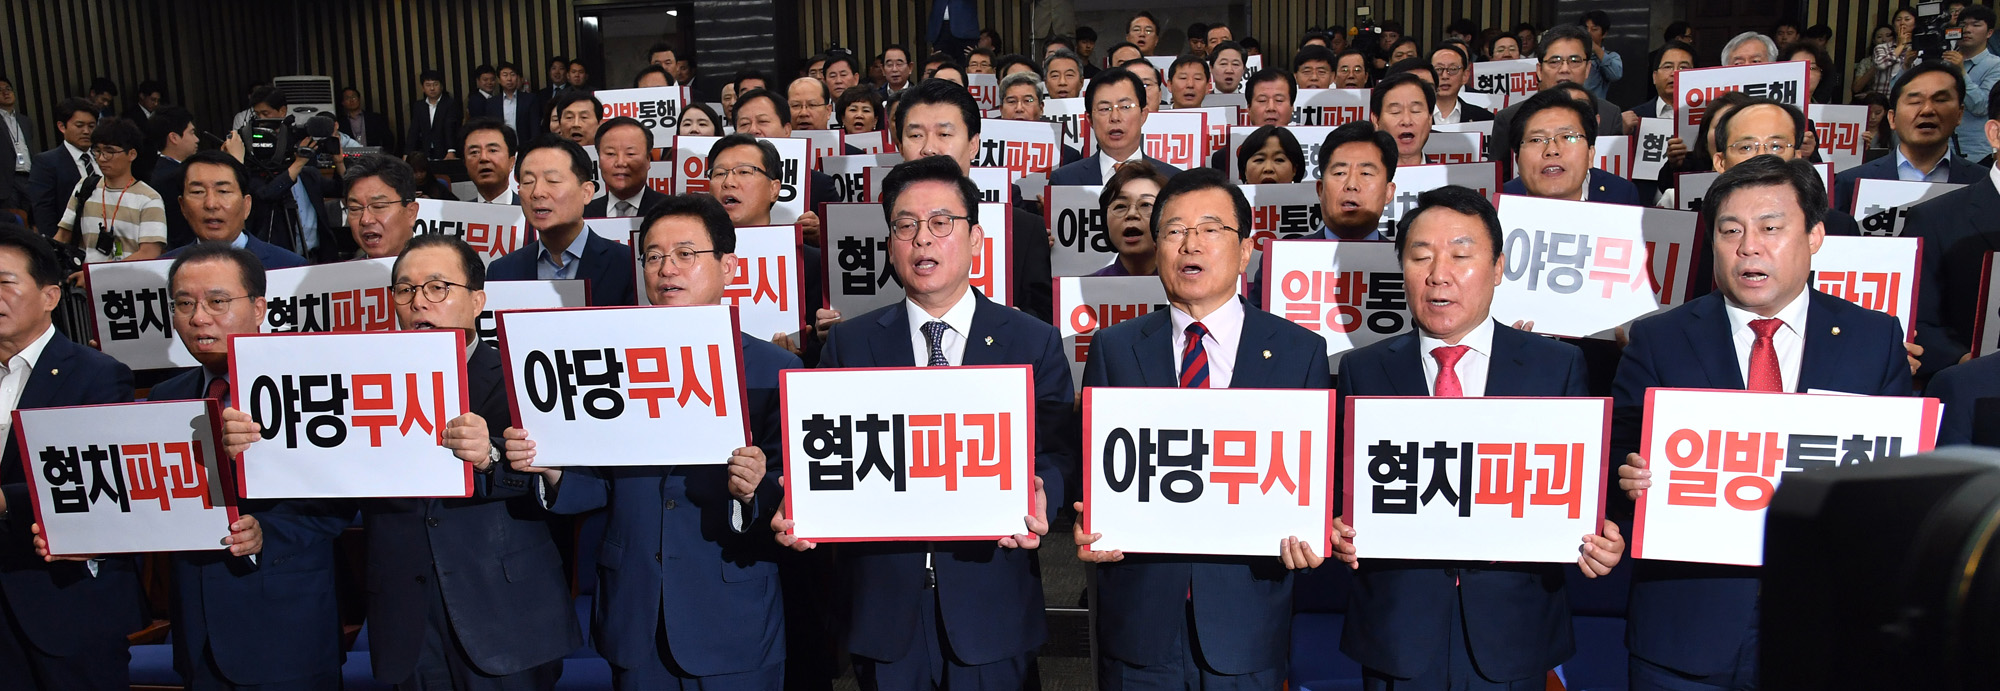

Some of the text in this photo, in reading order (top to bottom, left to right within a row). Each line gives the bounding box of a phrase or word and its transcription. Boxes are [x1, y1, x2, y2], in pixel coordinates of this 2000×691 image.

[968, 85, 996, 108] 무시
[971, 139, 1054, 180] 치파괴
[1140, 133, 1193, 170] 파괴
[1815, 121, 1860, 155] 파괴
[684, 156, 798, 203] 일행
[720, 255, 788, 312] 무시
[1503, 228, 1680, 305] 야당무시
[1811, 270, 1901, 317] 파괴
[101, 287, 173, 341] 협치
[1281, 270, 1416, 334] 일방통
[250, 371, 446, 449] 야당무시
[524, 344, 727, 421] 야당무시
[40, 440, 214, 514] 협치파괴
[802, 412, 1012, 492] 협치파괴
[1103, 427, 1312, 506] 야당무시
[1367, 439, 1585, 519] 협치파괴
